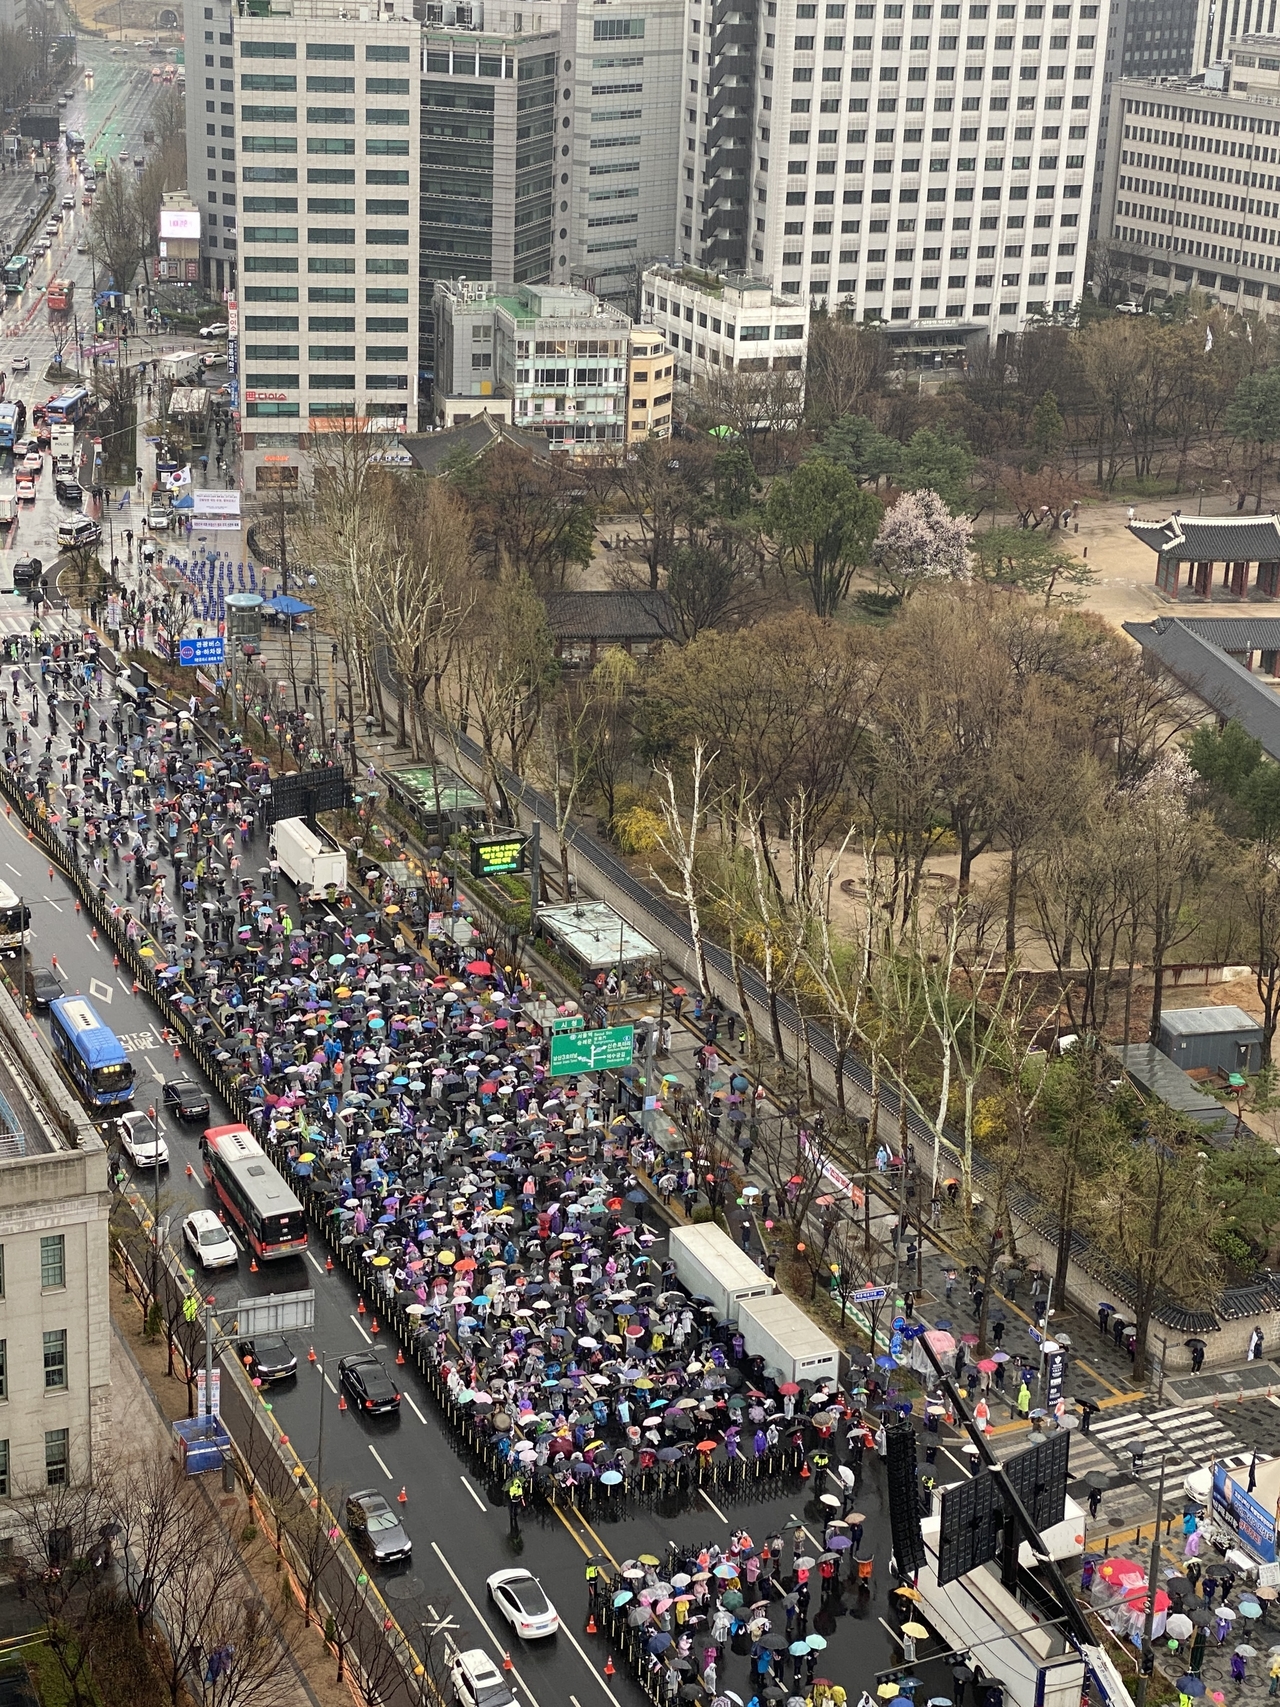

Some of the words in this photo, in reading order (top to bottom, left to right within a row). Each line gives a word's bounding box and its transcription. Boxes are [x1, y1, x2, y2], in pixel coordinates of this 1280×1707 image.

[229, 312, 237, 332] 다이소
[258, 392, 287, 400] 다이소
[196, 640, 221, 648] 관광버스
